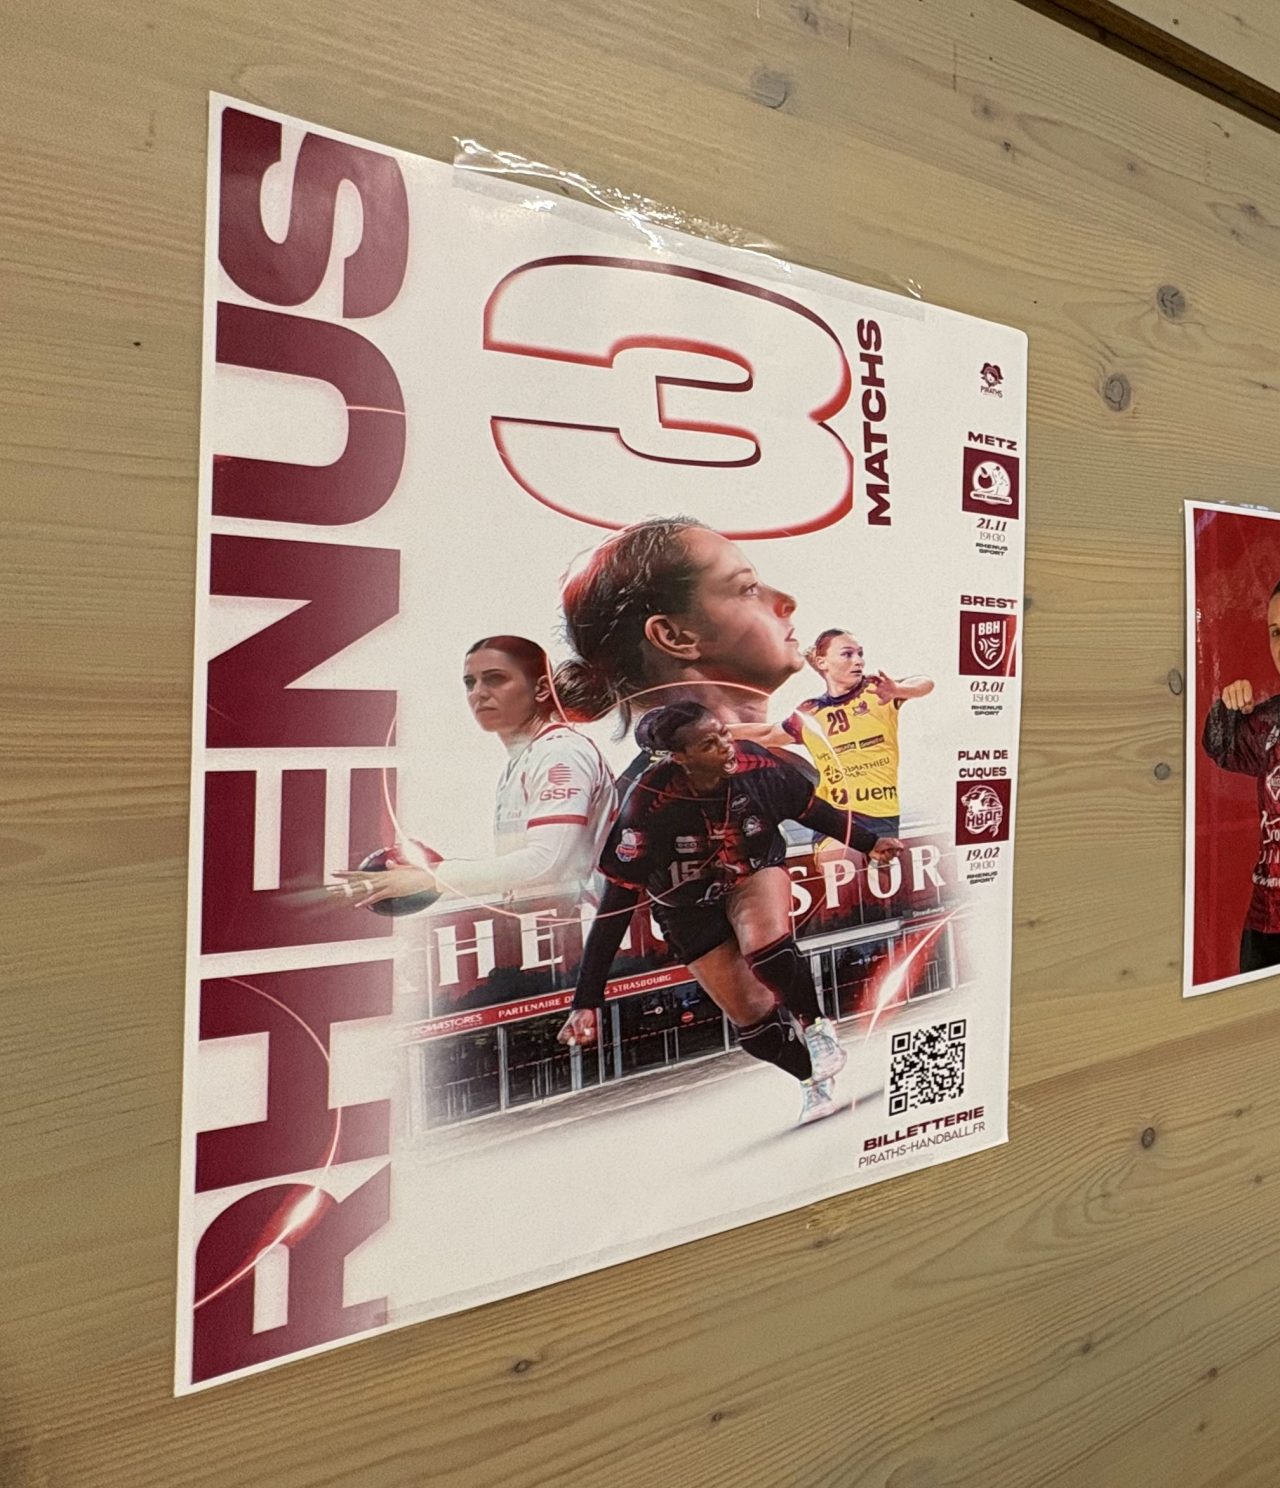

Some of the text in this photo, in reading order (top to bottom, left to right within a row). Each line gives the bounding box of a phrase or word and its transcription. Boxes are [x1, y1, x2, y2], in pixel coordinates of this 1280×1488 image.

[483, 254, 855, 541] 3
[857, 318, 892, 526] MATCHS
[967, 431, 1018, 451] METZ
[976, 517, 1007, 531] 21.11
[960, 594, 1018, 609] BREST
[978, 620, 1000, 636] BBH
[970, 680, 1005, 693] 03.01
[826, 708, 851, 737] 29
[191, 106, 409, 1385] RHENUS
[958, 749, 1008, 761] PLAN DE
[959, 766, 1007, 779] CUQUES
[539, 788, 581, 801] GSF
[966, 847, 1000, 861] 19.02
[612, 973, 672, 993] STRASBOURG
[498, 996, 562, 1018] PARTENAIRE
[863, 1105, 985, 1152] BILLETTERIE
[858, 1121, 986, 1169] PIRATHS-HANDBALL.FR
